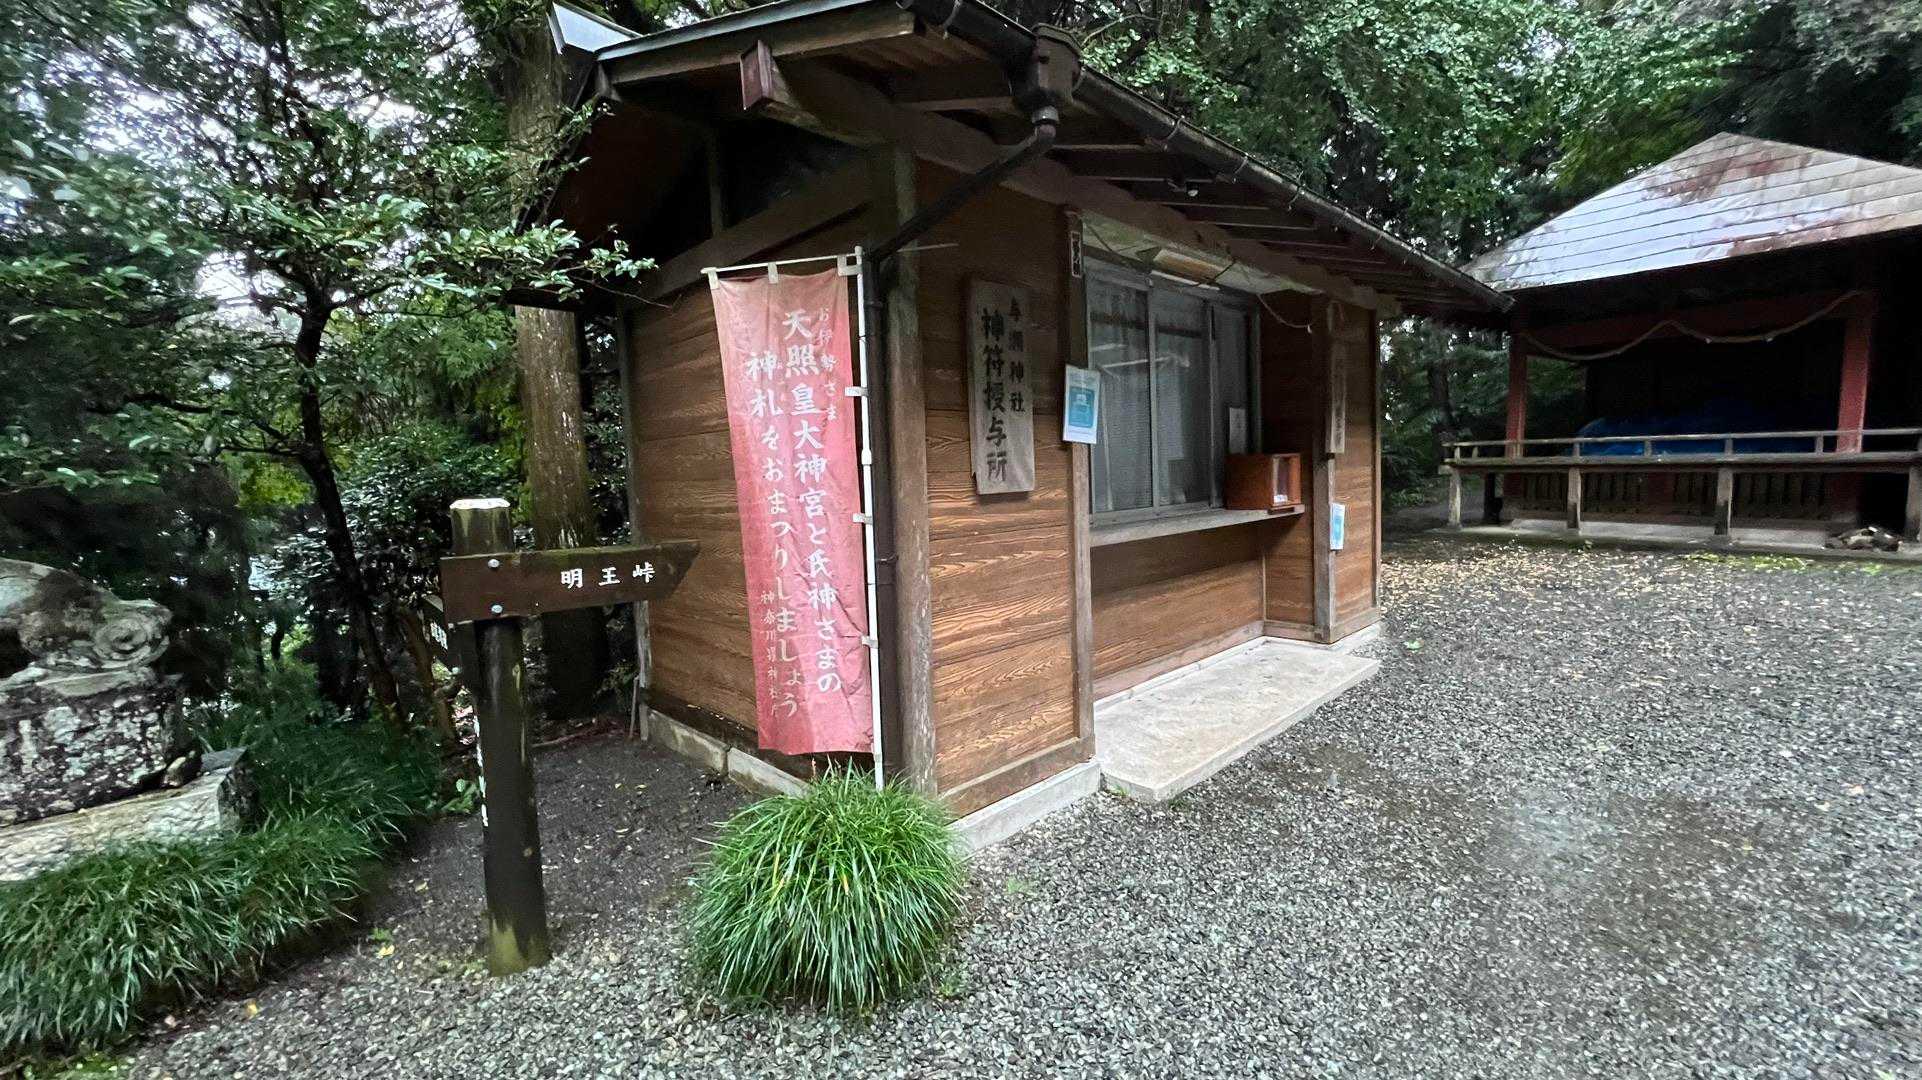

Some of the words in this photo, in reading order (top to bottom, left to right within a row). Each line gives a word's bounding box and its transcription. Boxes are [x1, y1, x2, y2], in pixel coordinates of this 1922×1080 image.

[783, 310, 841, 692] 天照皇大神宮と氏神さまの
[982, 308, 1007, 482] 神符授与所
[561, 562, 655, 588] 明王峠
[746, 351, 801, 717] 神札をおまつりしましょう
